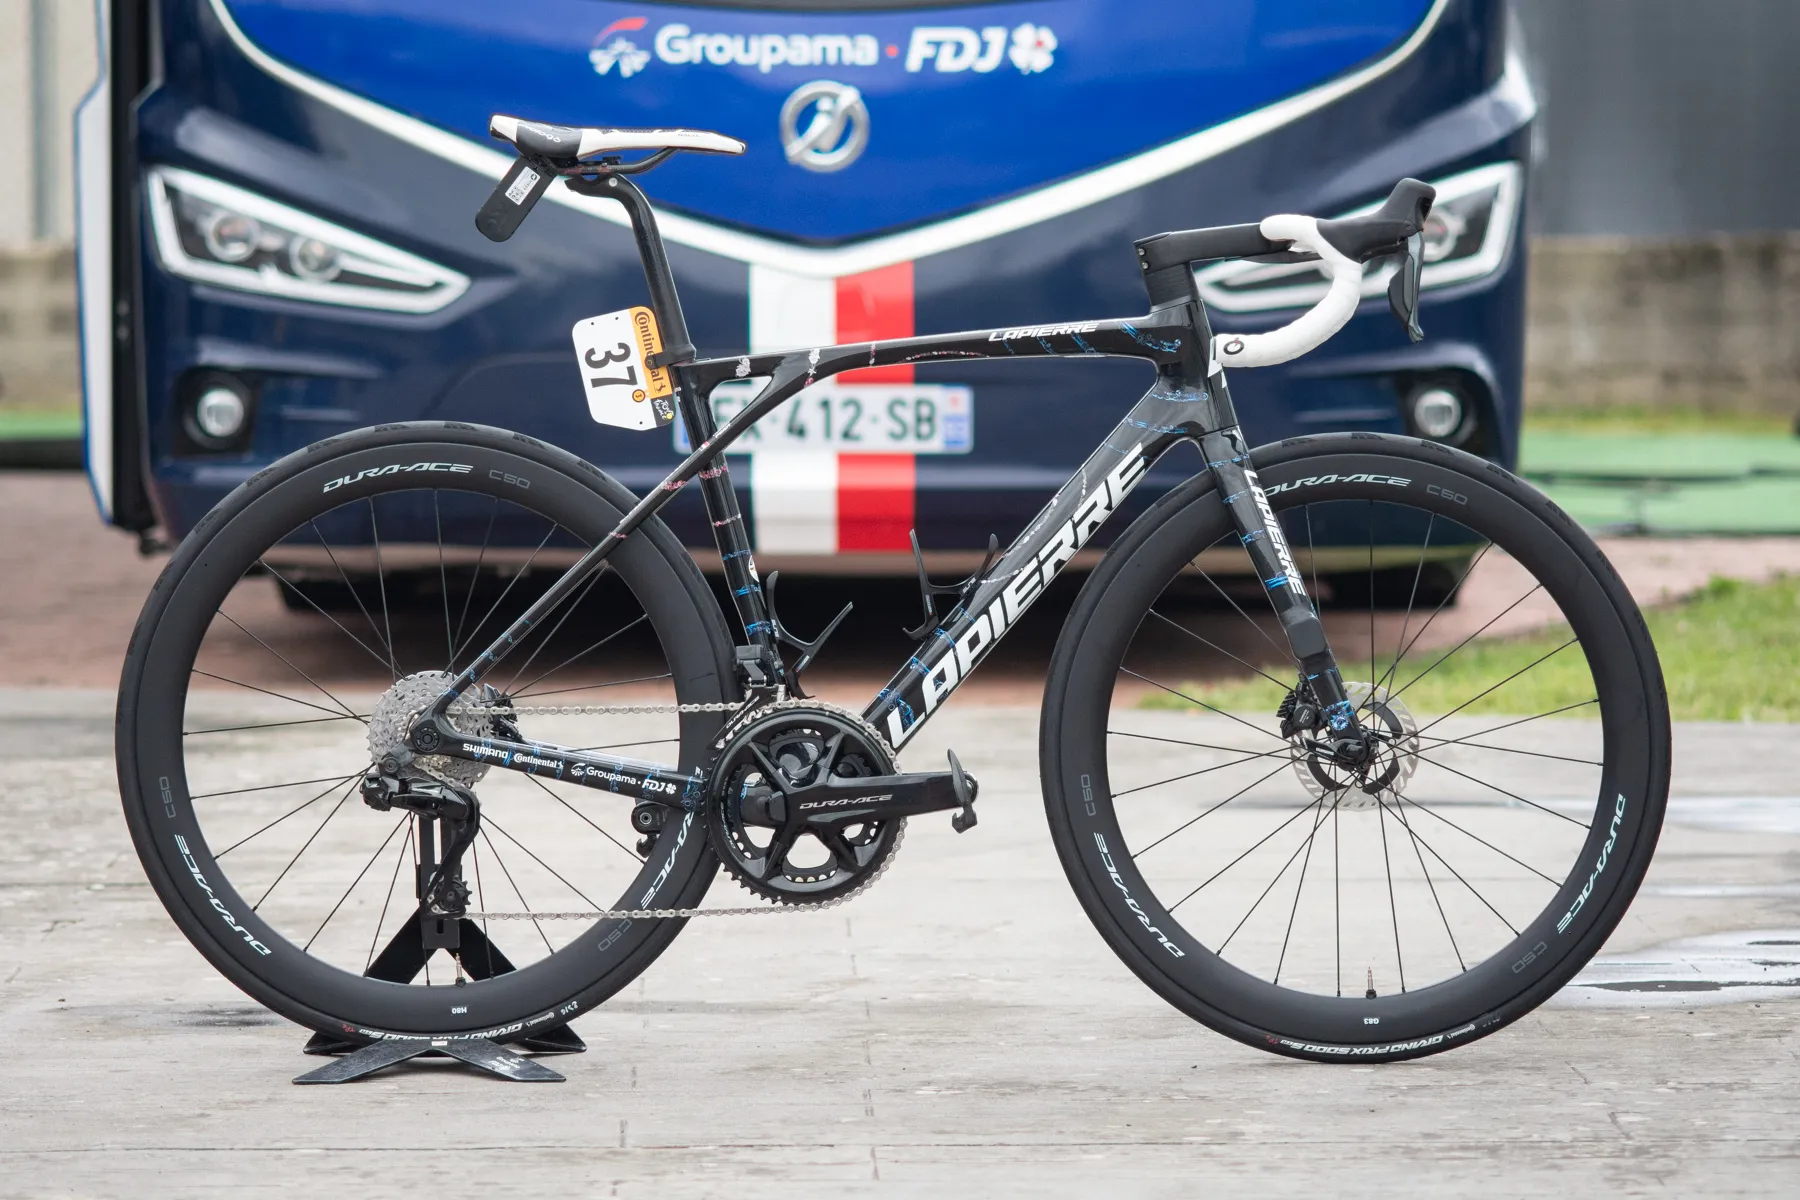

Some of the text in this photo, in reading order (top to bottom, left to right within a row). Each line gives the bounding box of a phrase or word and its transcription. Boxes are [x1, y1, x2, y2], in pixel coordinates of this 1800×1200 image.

[654, 23, 1007, 73] Groupama FDJ
[634, 311, 664, 383] Contineal
[988, 323, 1100, 342] LAPIERRE
[584, 342, 638, 389] 37
[323, 462, 531, 493] DURA-ACE C50
[1263, 473, 1468, 506] DURA-ACE C50
[1244, 469, 1306, 596] LAPIERRE
[887, 442, 1148, 749] LAPIERRE
[462, 743, 508, 759] SHIMANO
[513, 752, 557, 768] Continental
[586, 766, 667, 792] Groupama FDJ
[800, 794, 893, 810] DURA-ACE
[158, 776, 272, 956] DURA-ACE C50
[1081, 774, 1186, 958] DURA-ACE C50
[1512, 793, 1626, 974] DURA-ACE C50
[598, 918, 633, 951] C50
[469, 1022, 523, 1040] GRAND
[1389, 1034, 1444, 1053] GRAND
[1305, 1045, 1351, 1055] 5000
[1350, 1046, 1390, 1055] PRIX
